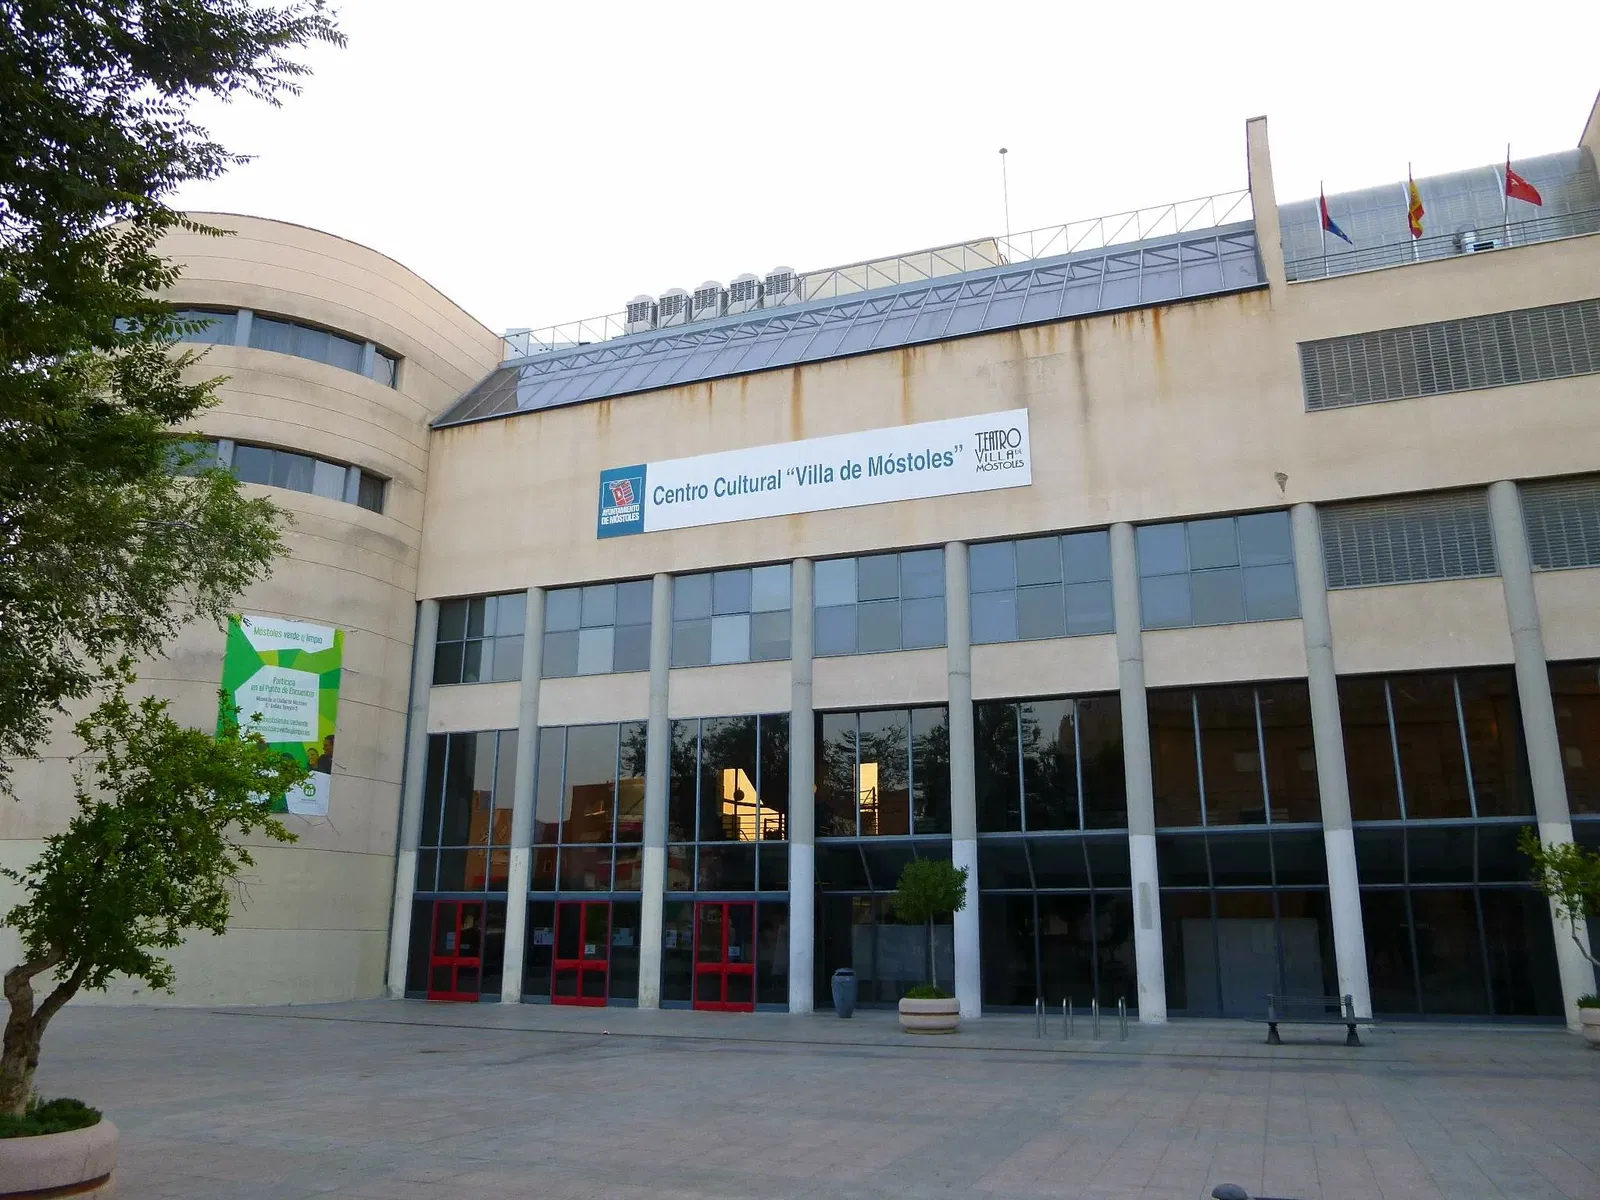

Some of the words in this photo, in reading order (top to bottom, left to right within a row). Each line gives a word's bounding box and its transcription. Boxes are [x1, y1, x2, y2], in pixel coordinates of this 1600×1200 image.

[975, 428, 1021, 452] TEATRO
[975, 448, 1014, 463] VILLA
[976, 460, 1024, 473] MÓSTOLES
[653, 484, 708, 506] Centro
[714, 469, 781, 497] Cultural
[786, 464, 833, 486] “Villa
[840, 460, 862, 481] de
[868, 444, 963, 477] Móstoles”
[601, 504, 640, 516] AYUNTAMIENTO
[601, 516, 609, 525] DE
[283, 631, 300, 641] verde
[306, 633, 323, 644] limpio
[272, 676, 296, 687] Participa
